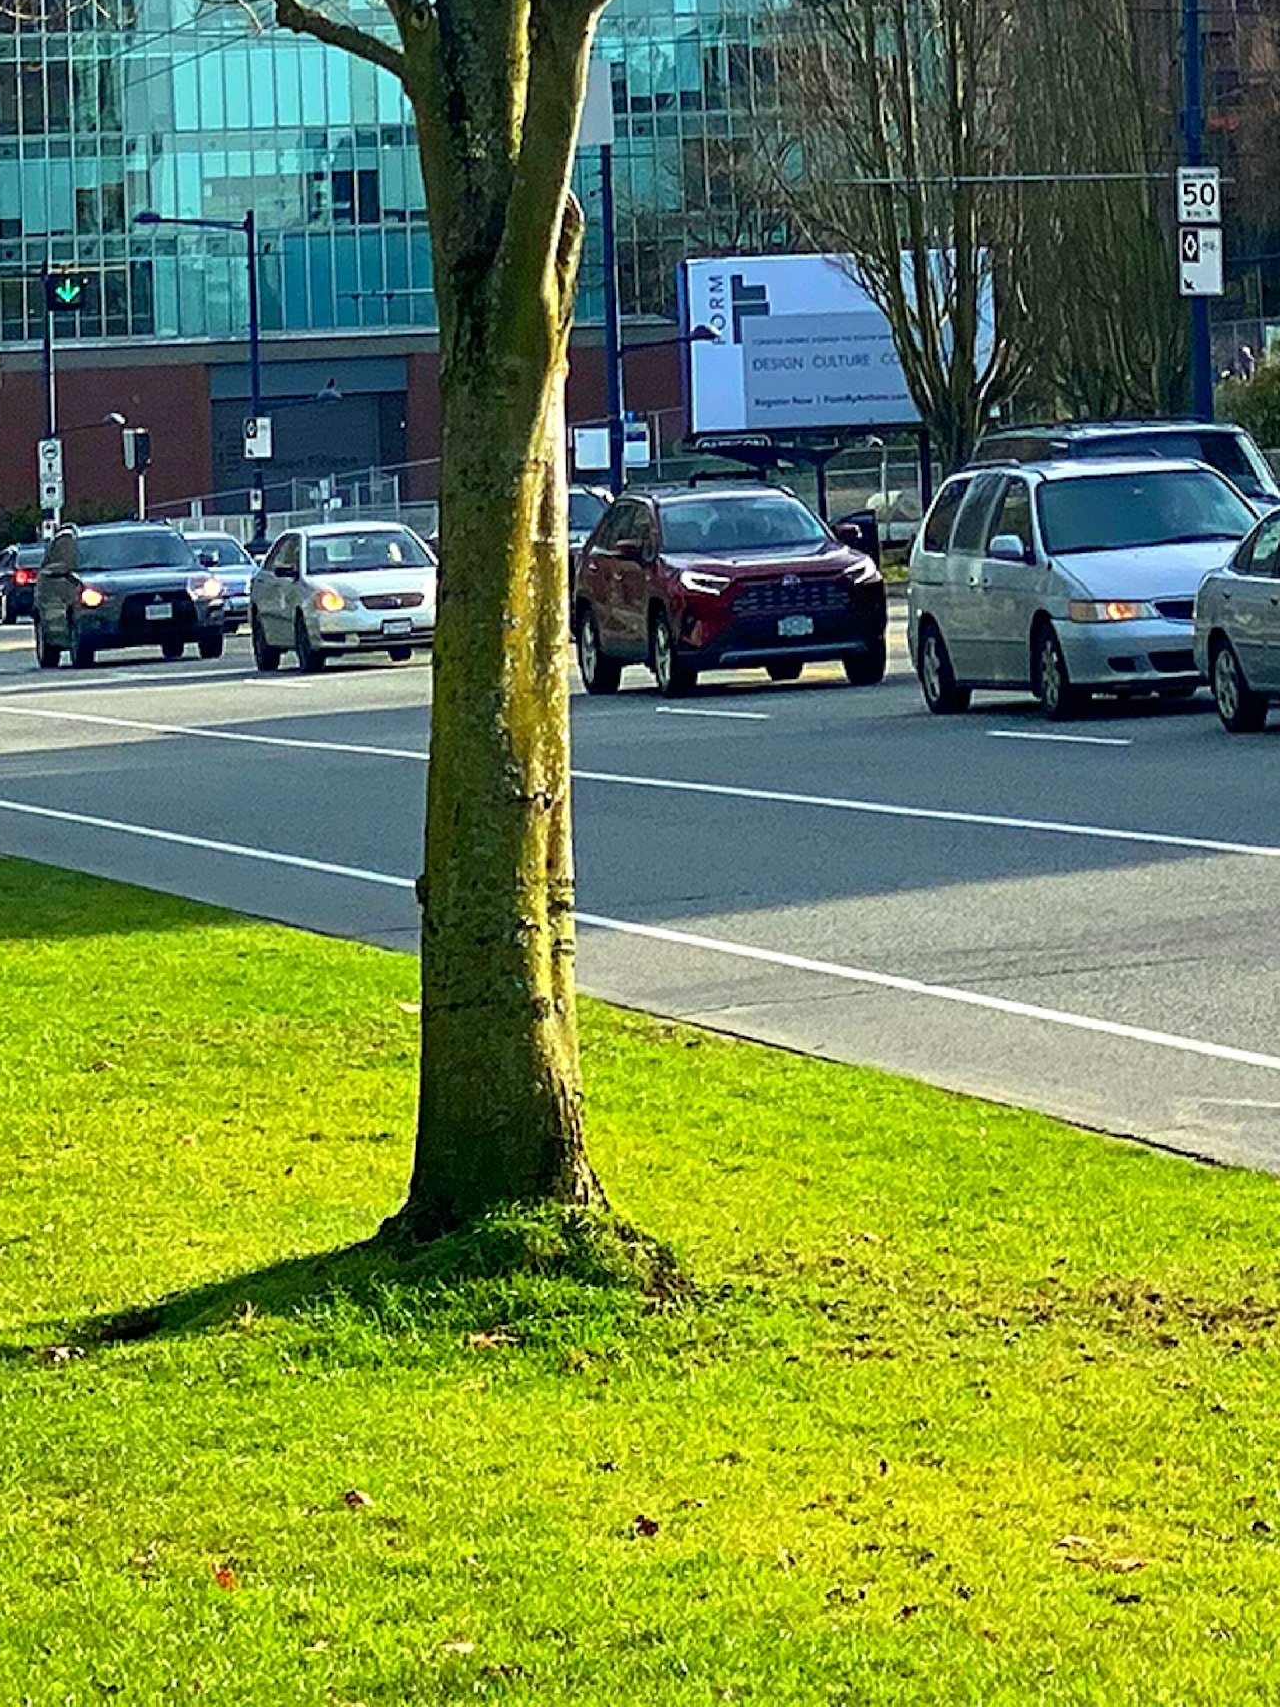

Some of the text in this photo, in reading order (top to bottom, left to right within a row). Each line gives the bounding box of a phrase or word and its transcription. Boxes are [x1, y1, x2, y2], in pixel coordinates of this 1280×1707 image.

[1184, 183, 1215, 206] 50
[752, 355, 804, 372] DESIGN
[812, 353, 871, 369] CULTURE
